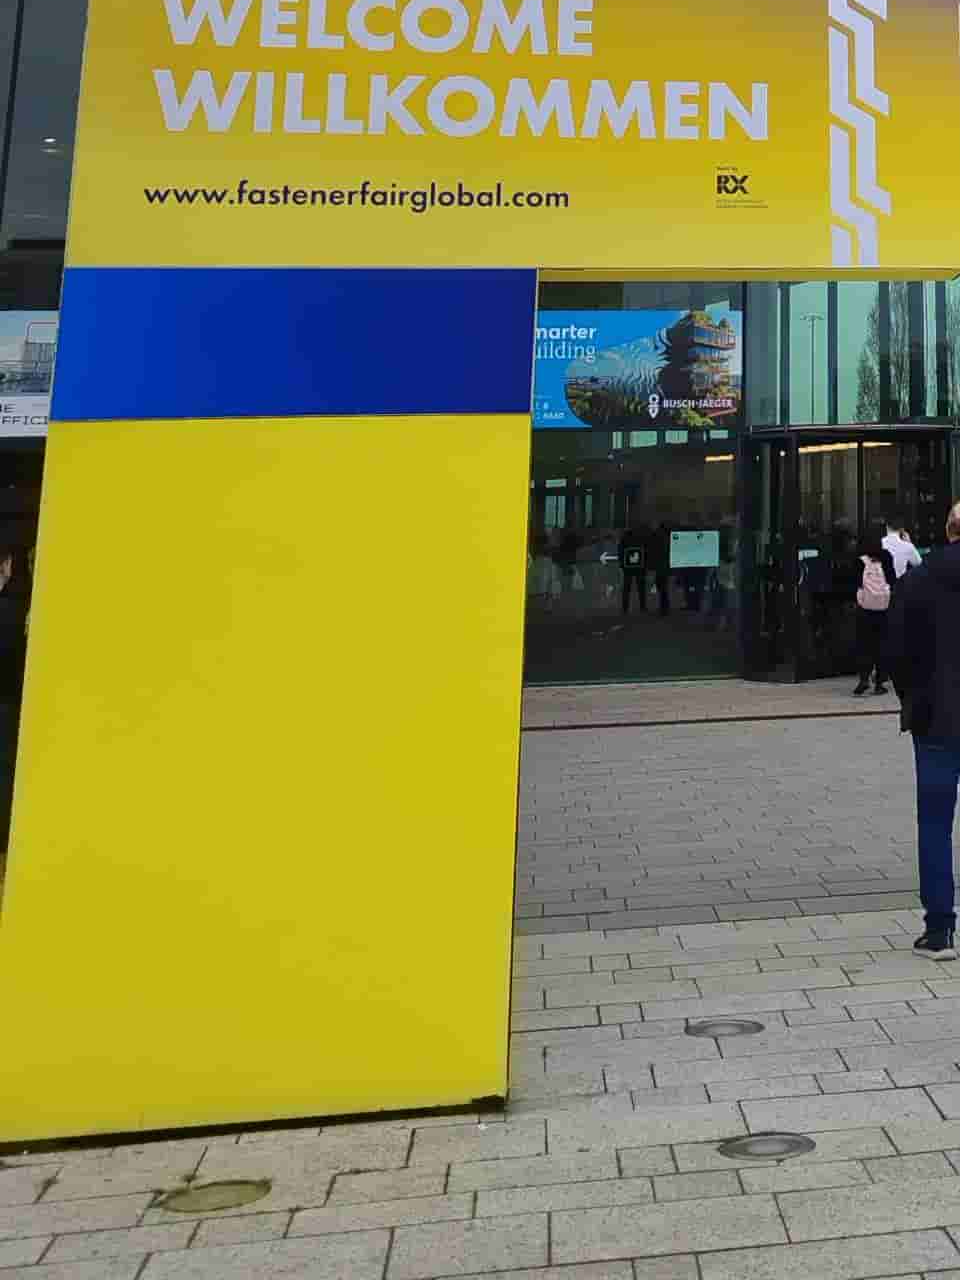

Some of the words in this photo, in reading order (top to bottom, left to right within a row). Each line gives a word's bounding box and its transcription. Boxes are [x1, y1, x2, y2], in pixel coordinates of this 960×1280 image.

[152, 68, 769, 141] WILLKOMMEN
[144, 179, 570, 213] www.fastenerfairglobal.com
[717, 174, 750, 195] RX
